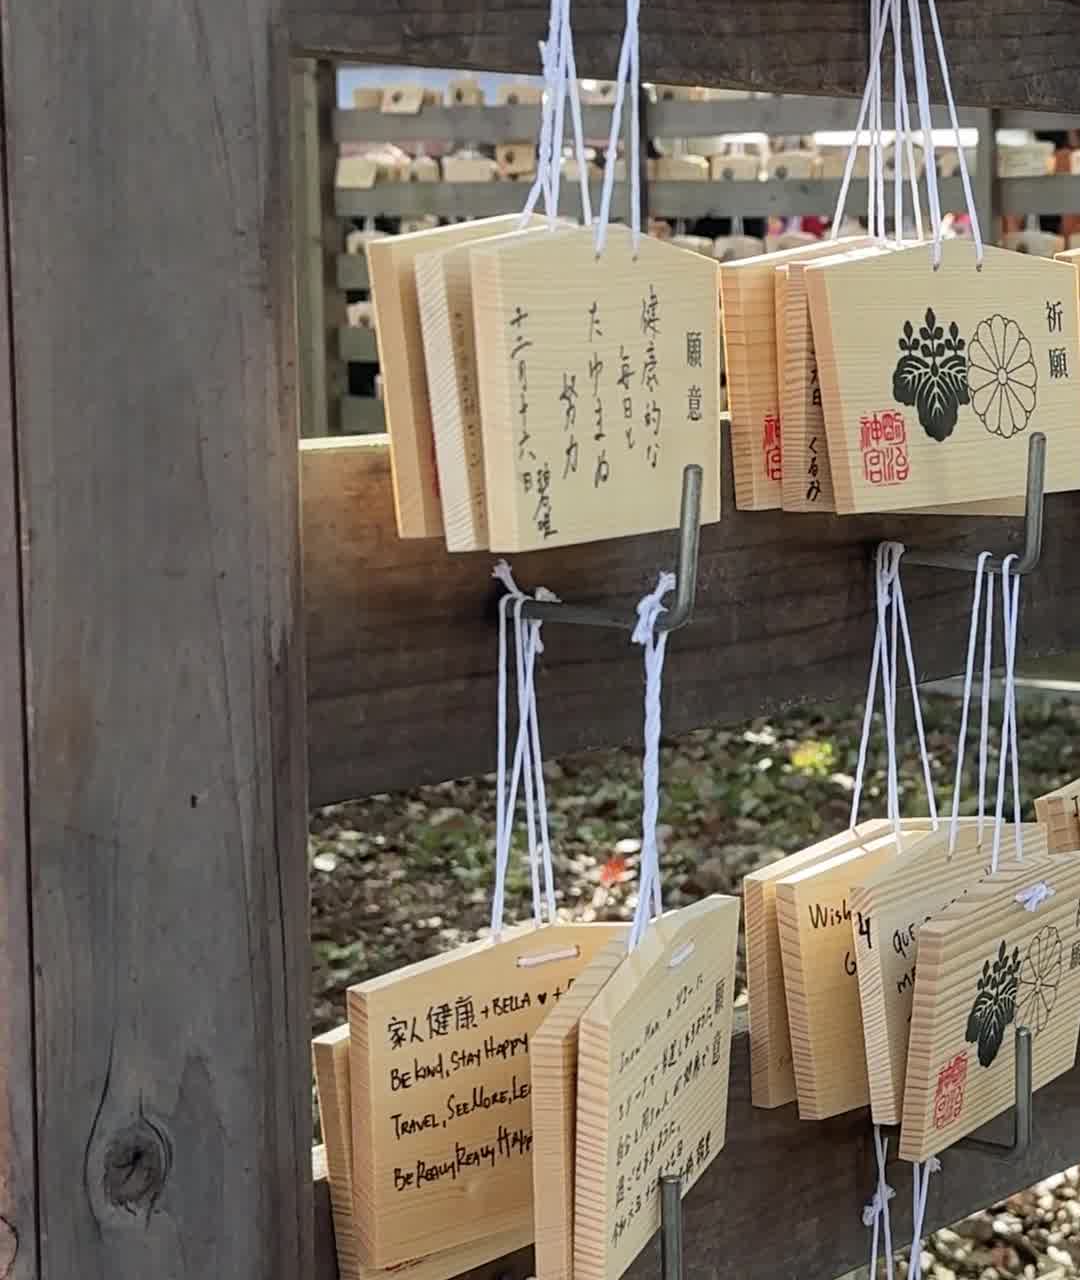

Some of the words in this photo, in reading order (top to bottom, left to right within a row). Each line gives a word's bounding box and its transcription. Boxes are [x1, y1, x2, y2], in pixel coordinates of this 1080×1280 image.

[686, 331, 702, 421] 願意
[1045, 301, 1069, 380] 祈願
[806, 436, 823, 502] くるみ
[388, 994, 478, 1051] 家人健康
